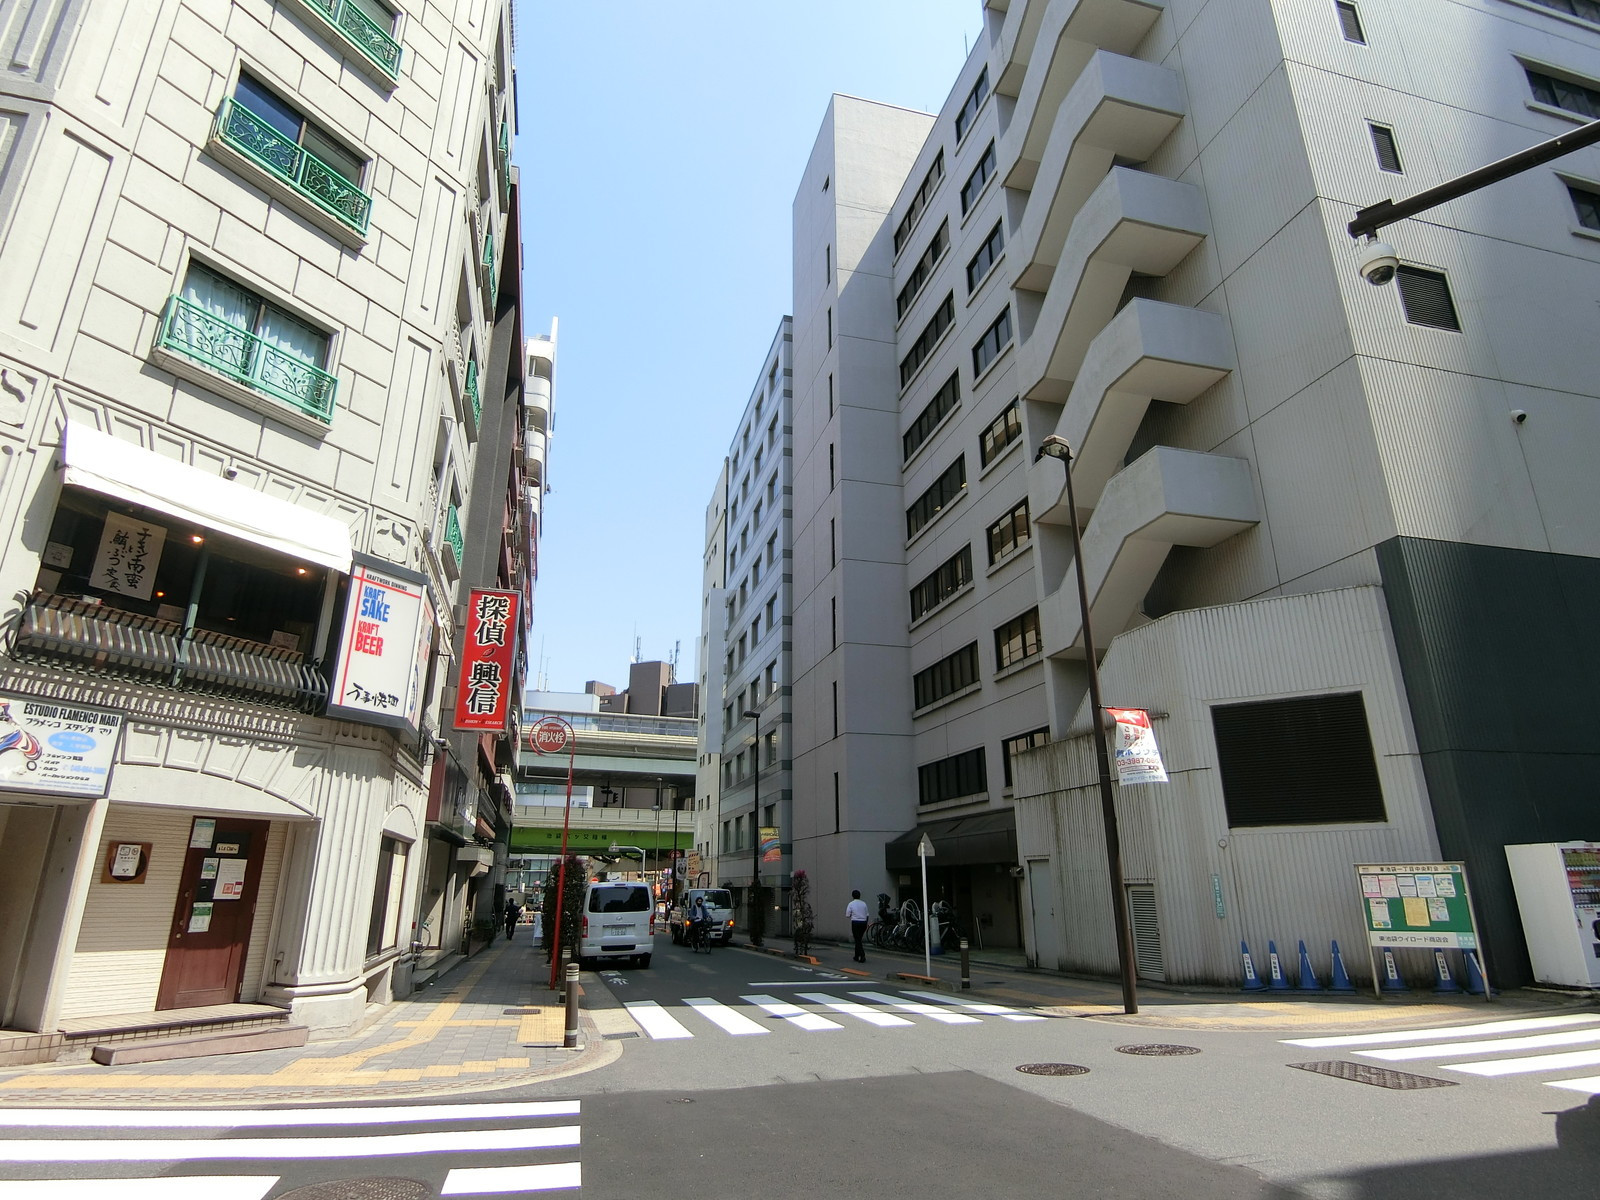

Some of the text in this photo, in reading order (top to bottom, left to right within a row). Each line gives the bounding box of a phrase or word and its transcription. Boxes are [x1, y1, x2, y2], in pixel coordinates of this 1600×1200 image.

[366, 574, 391, 587] KRAFTWORK
[363, 585, 387, 602] KRAFT
[361, 598, 391, 623] SAKE
[357, 620, 380, 637] KRAFT
[354, 633, 384, 657] BEER
[466, 594, 510, 715] 探偵 興信
[23, 702, 120, 728] ESTUDIO FLAMENCO MARI
[25, 717, 113, 736] フラメンコ スタジオ マリ
[538, 731, 565, 744] 消火栓
